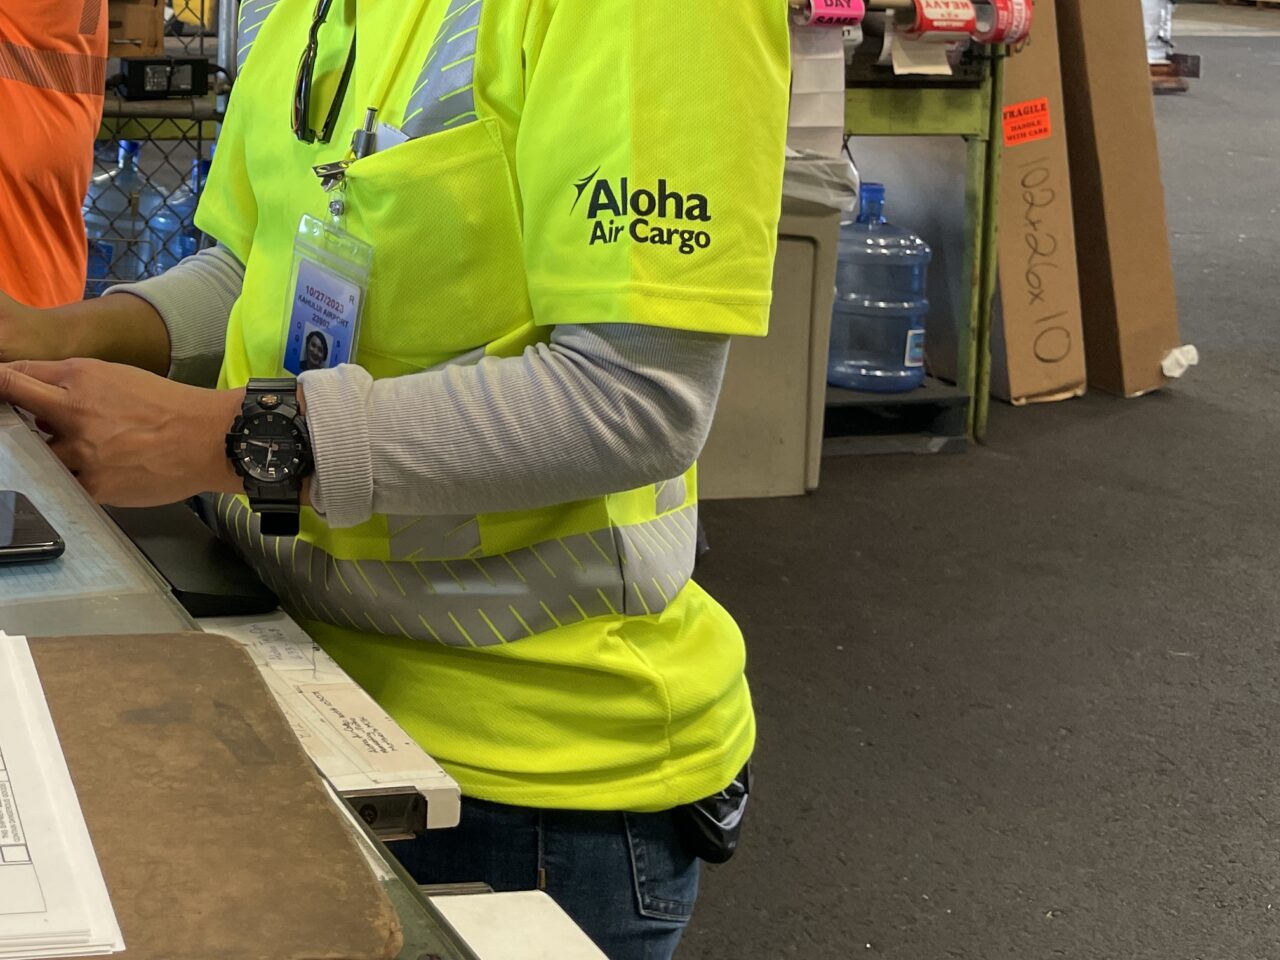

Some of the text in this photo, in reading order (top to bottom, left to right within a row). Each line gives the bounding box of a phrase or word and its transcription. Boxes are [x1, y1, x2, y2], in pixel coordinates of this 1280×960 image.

[925, 0, 971, 10] HEAVY
[816, 16, 858, 25] SAME
[1003, 103, 1047, 121] FRAGILE
[1006, 128, 1048, 140] WITH CARE
[1010, 120, 1041, 132] HANDLE
[587, 176, 712, 222] Aloha
[589, 218, 711, 254] Air Cargo
[305, 284, 344, 314] 10/27/2023
[322, 308, 350, 329] AIRPORT
[3, 798, 16, 823] DANGEROUS
[0, 829, 10, 838] THIS
[9, 824, 21, 842] CONTAIN
